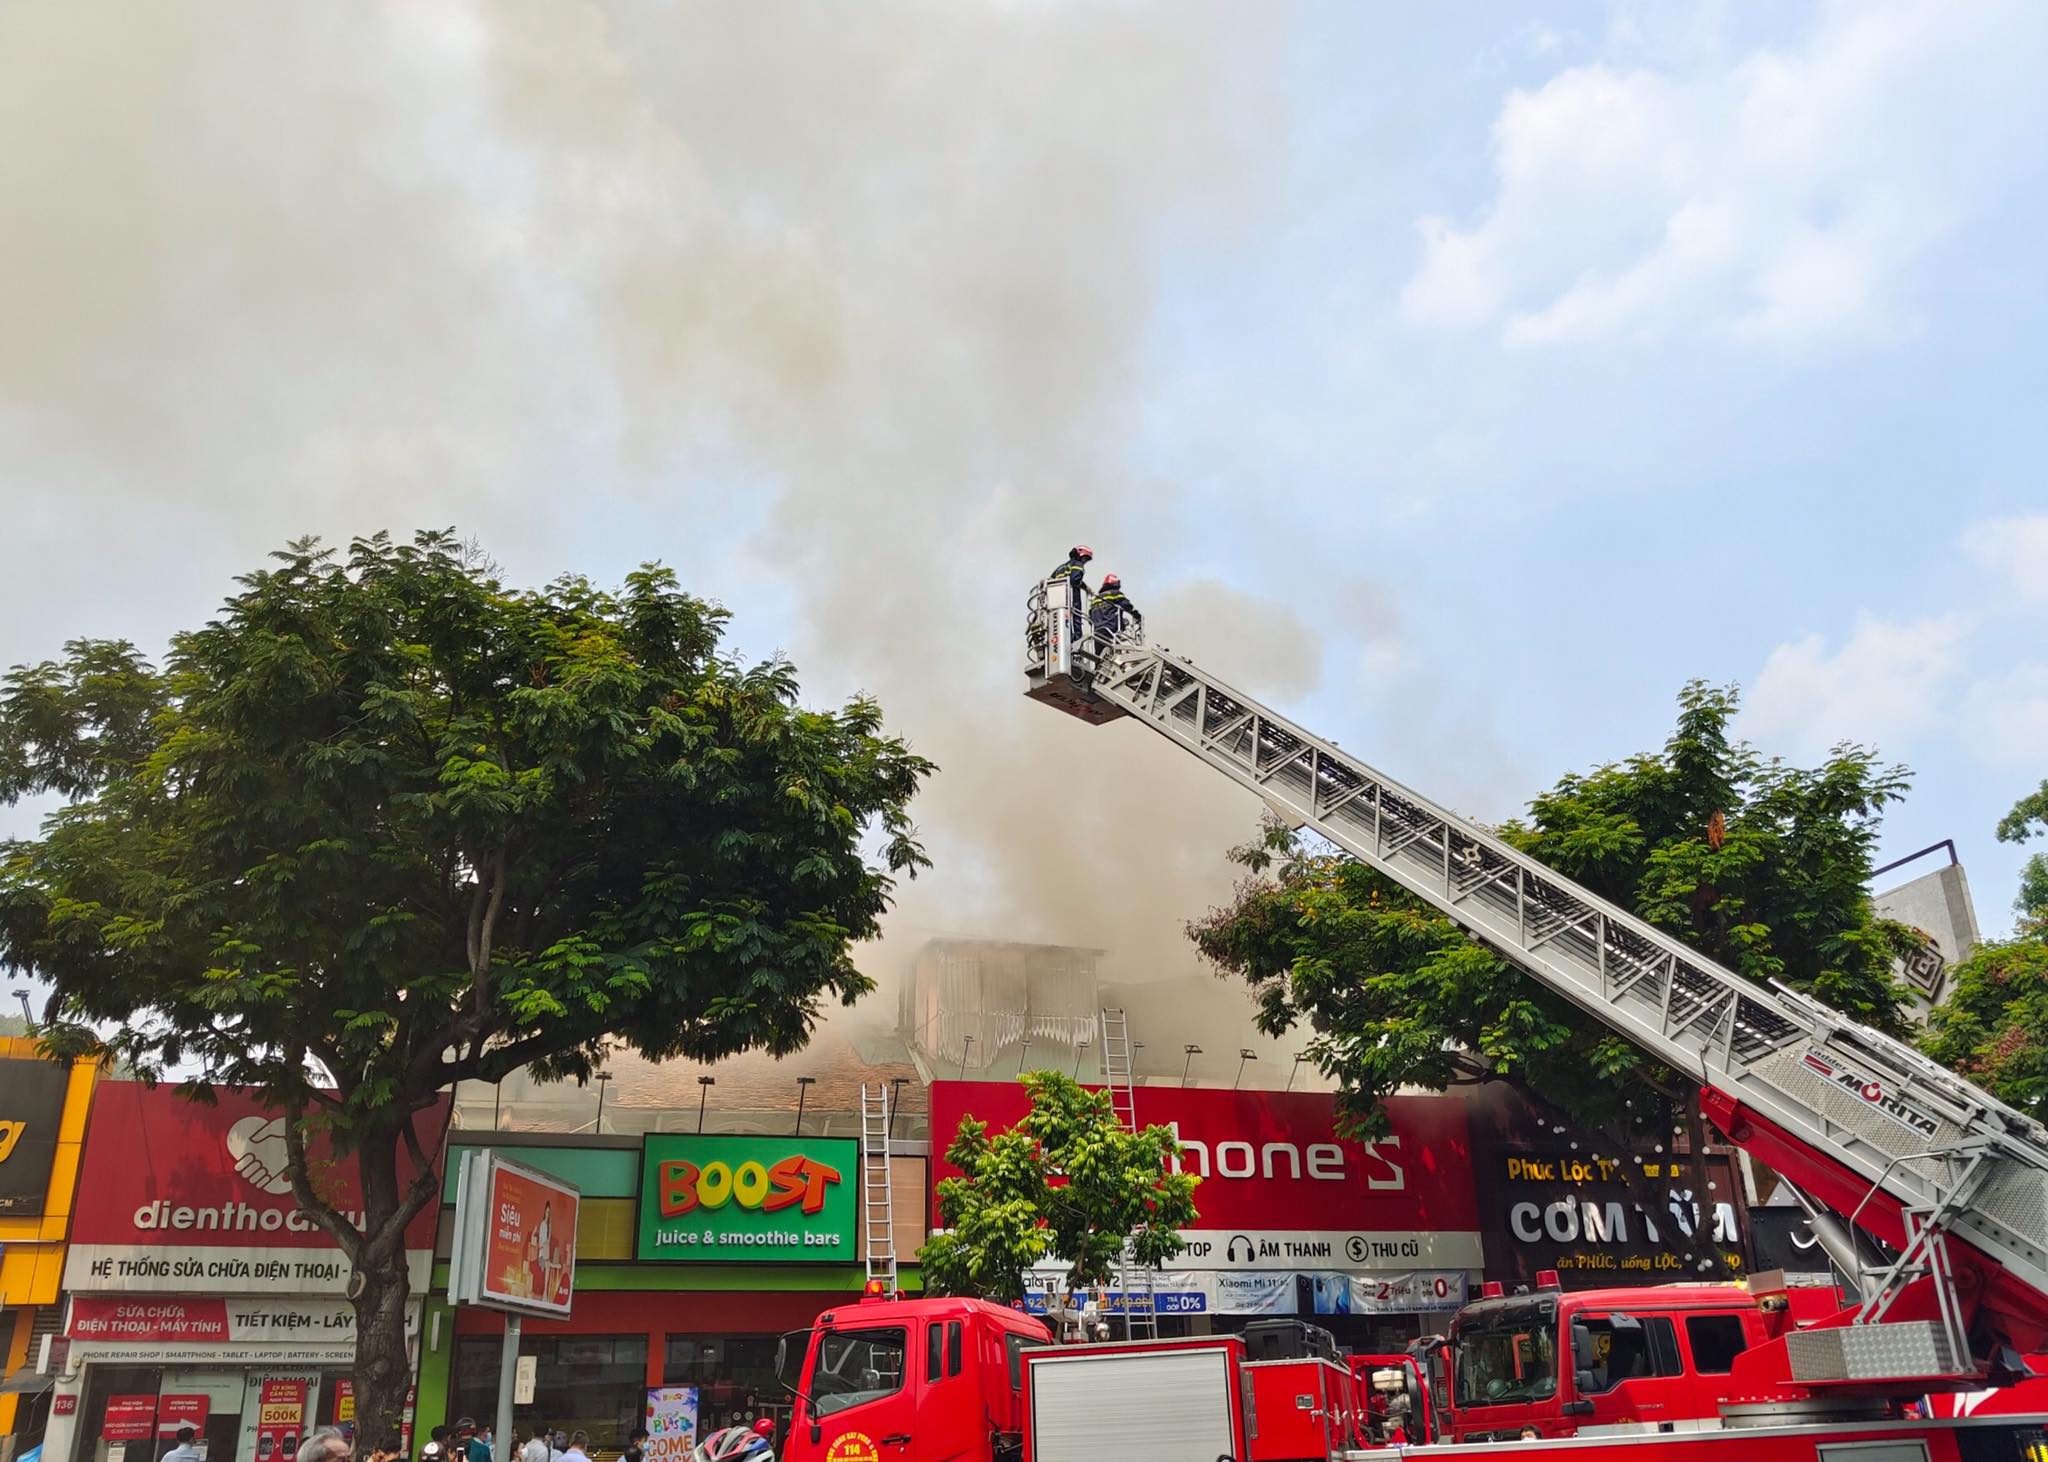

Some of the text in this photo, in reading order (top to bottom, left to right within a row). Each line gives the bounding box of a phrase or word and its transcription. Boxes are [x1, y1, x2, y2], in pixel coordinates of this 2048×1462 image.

[1807, 1046, 1848, 1071] Ladder
[1838, 1074, 1938, 1135] MORITA
[1507, 1158, 1555, 1180] Phúc
[1560, 1159, 1593, 1187] Lộc
[660, 1154, 841, 1218] BOOST
[500, 1203, 520, 1227] Siêu
[1511, 1195, 1628, 1242] CƠM
[656, 1229, 841, 1246] juice & smoothie bars
[1259, 1239, 1280, 1257] ÂM
[1284, 1242, 1331, 1257] THANH
[1372, 1242, 1397, 1257] THU
[1401, 1240, 1419, 1257] CŨ
[91, 1257, 113, 1279] HỆ
[118, 1256, 170, 1277] THỐNG
[173, 1257, 204, 1277] SỬA
[208, 1259, 250, 1277] CHỮA
[254, 1260, 290, 1281] ĐIỆN
[294, 1263, 340, 1281] THOẠI
[1621, 1255, 1650, 1271] uống
[1219, 1278, 1252, 1288] Xiaomi
[1254, 1278, 1266, 1288] Mi
[1377, 1282, 1390, 1300] 2
[1180, 1296, 1201, 1310] 0%
[77, 1318, 108, 1333] ĐIỆN
[111, 1320, 151, 1335] THOẠI
[160, 1319, 188, 1333] MÁY
[190, 1320, 222, 1333] TÍNH
[235, 1310, 269, 1328] TIẾT
[271, 1312, 311, 1331] KIỆM
[323, 1311, 354, 1329] LẤY
[83, 1351, 110, 1359] PHONE
[111, 1351, 137, 1359] REPAIR
[138, 1351, 160, 1359] SHOP
[165, 1351, 216, 1359] SMARTPHONE
[222, 1351, 248, 1359] TABLET
[254, 1351, 283, 1359] LAPTOP
[287, 1351, 319, 1359] BATTERY
[325, 1351, 353, 1359] SCREEN
[56, 1400, 74, 1410] 136
[264, 1410, 298, 1421] 500K
[647, 1435, 693, 1457] COME
[844, 1443, 861, 1456] 114
